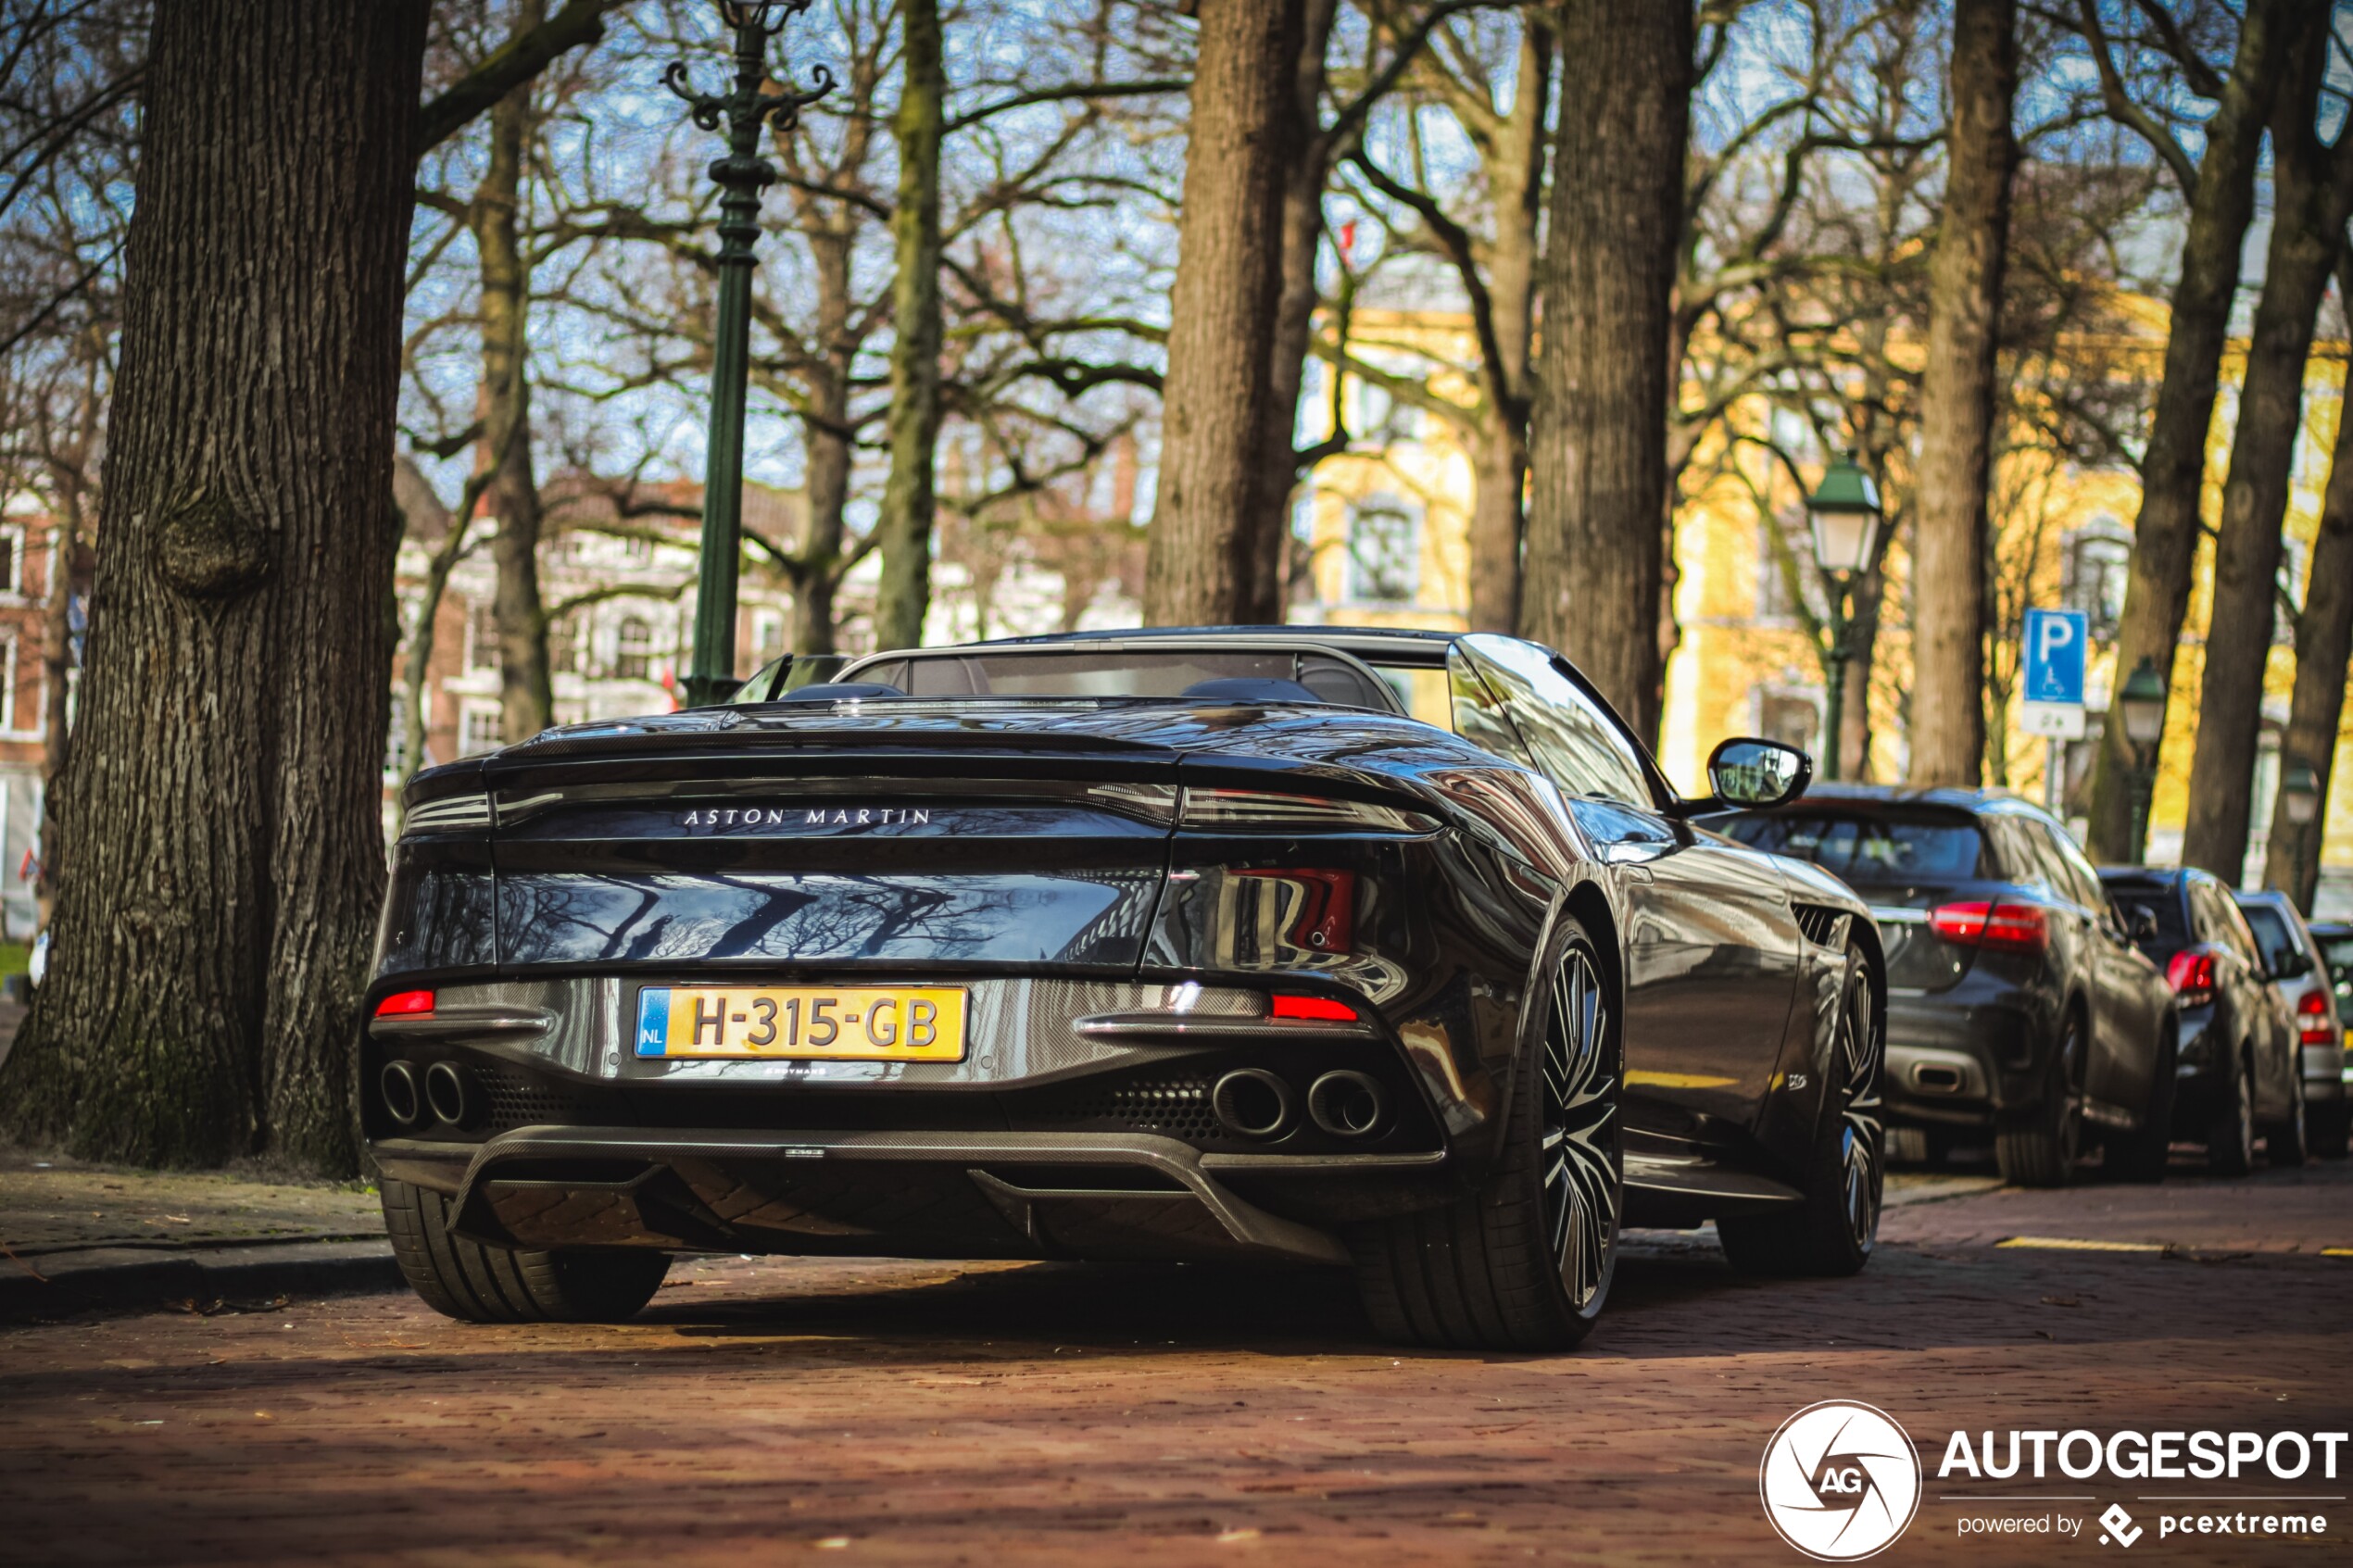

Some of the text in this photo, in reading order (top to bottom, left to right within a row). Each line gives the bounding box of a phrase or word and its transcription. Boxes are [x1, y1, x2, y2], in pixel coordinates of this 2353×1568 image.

[2040, 615, 2073, 663] P
[685, 809, 930, 824] ASTON MARTIN
[643, 1029, 662, 1043] NL
[694, 997, 937, 1047] H-315-GB
